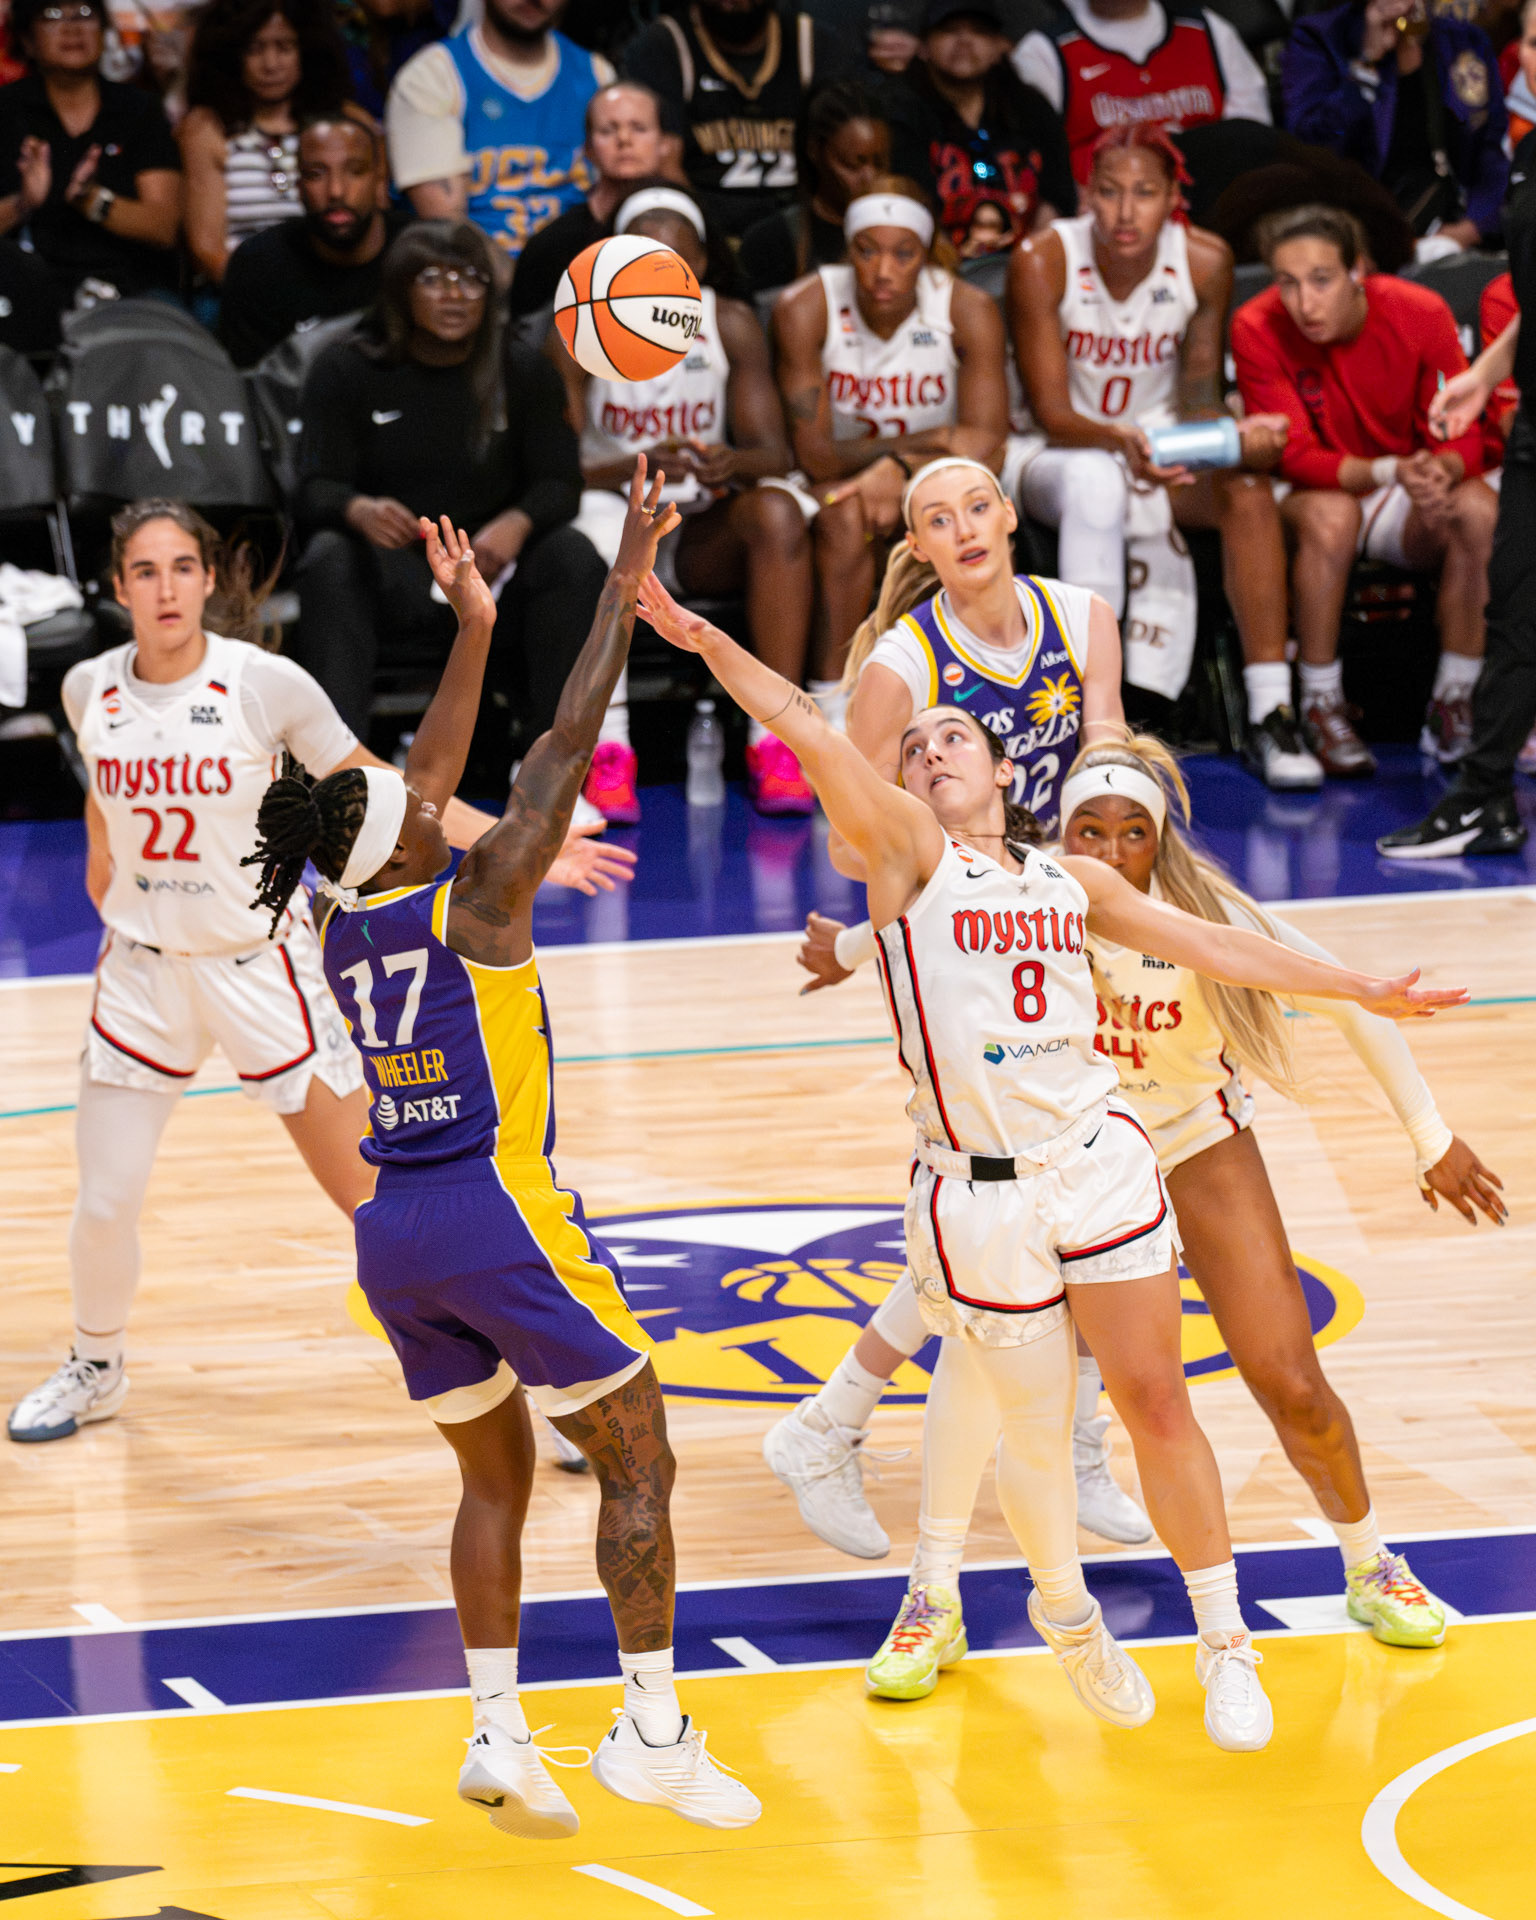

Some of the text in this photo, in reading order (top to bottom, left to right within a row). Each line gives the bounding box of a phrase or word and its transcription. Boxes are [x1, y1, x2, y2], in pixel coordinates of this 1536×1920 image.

[716, 149, 798, 187] 22
[827, 370, 948, 410] mystics
[1101, 375, 1132, 417] 0
[190, 705, 217, 715] CAR
[971, 706, 1015, 737] OS
[97, 752, 233, 799] mystics
[132, 807, 200, 862] 22
[151, 880, 216, 895] VANDA
[952, 907, 1083, 956] mystics
[339, 948, 430, 1049] 17
[1011, 960, 1047, 1023] 8
[369, 1049, 449, 1088] WHEELER
[1007, 1038, 1070, 1060] VANDA
[404, 1094, 461, 1124] AT&T
